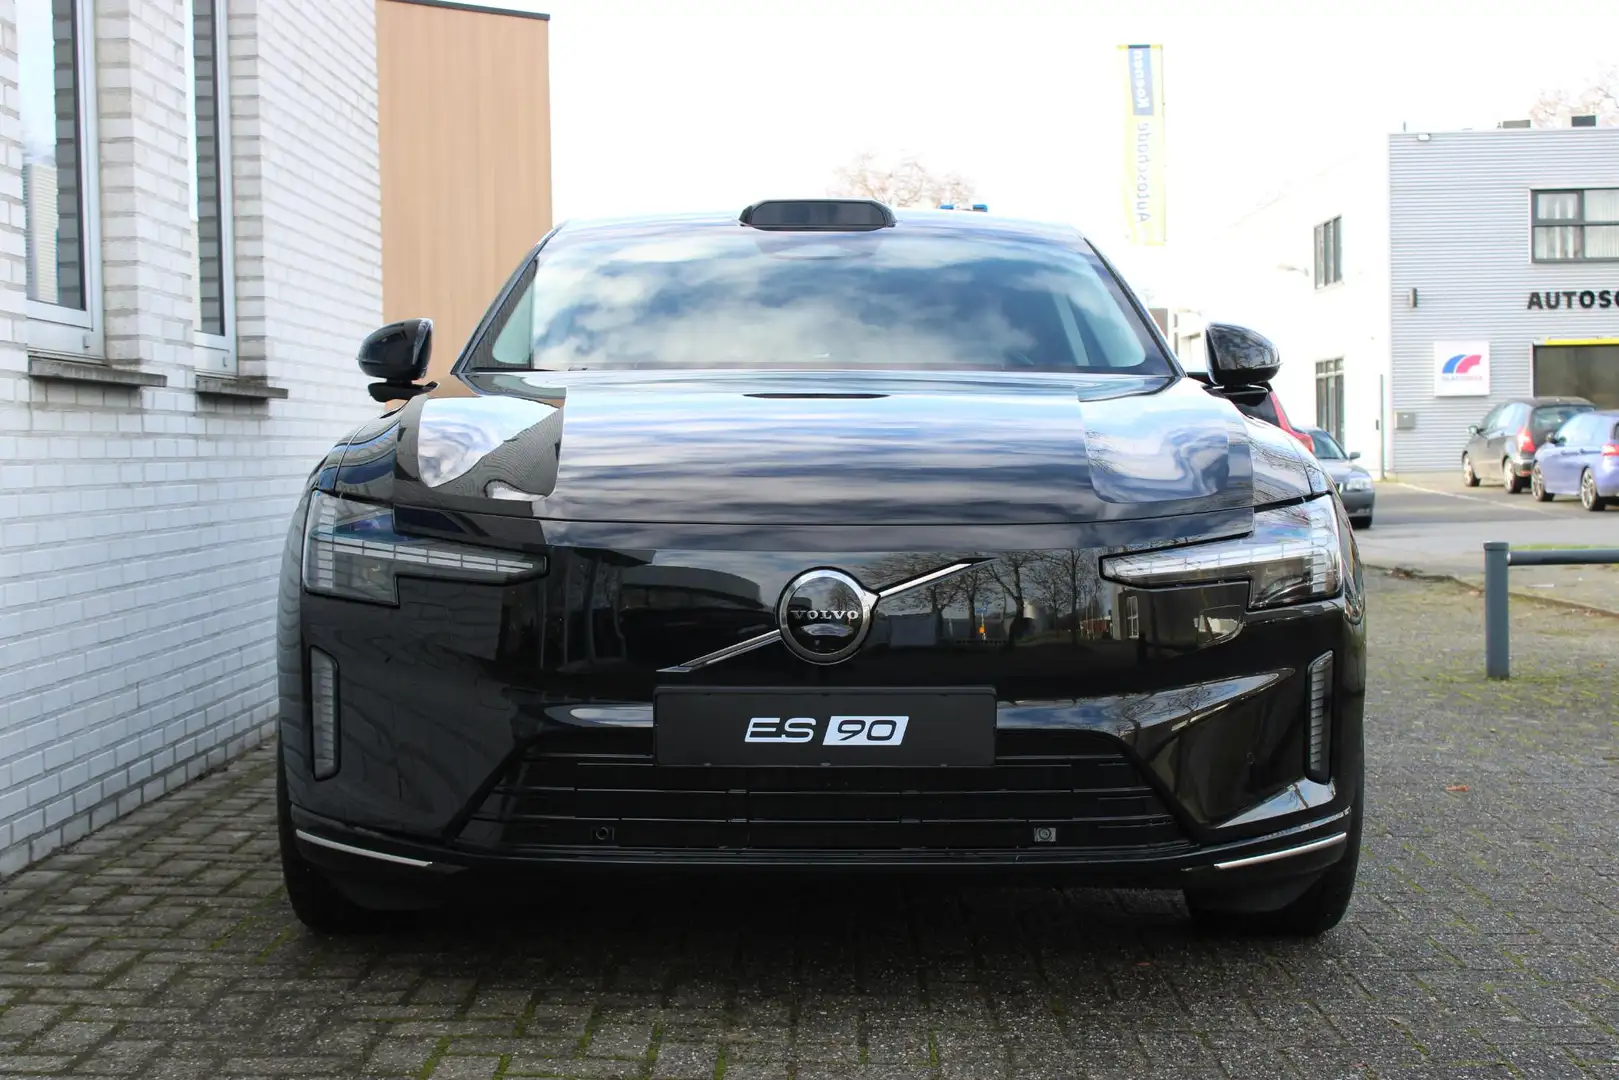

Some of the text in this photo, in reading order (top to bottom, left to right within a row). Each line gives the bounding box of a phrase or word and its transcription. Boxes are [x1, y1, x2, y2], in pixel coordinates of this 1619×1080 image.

[790, 610, 859, 620] VOLVO
[744, 717, 898, 743] ES 90
